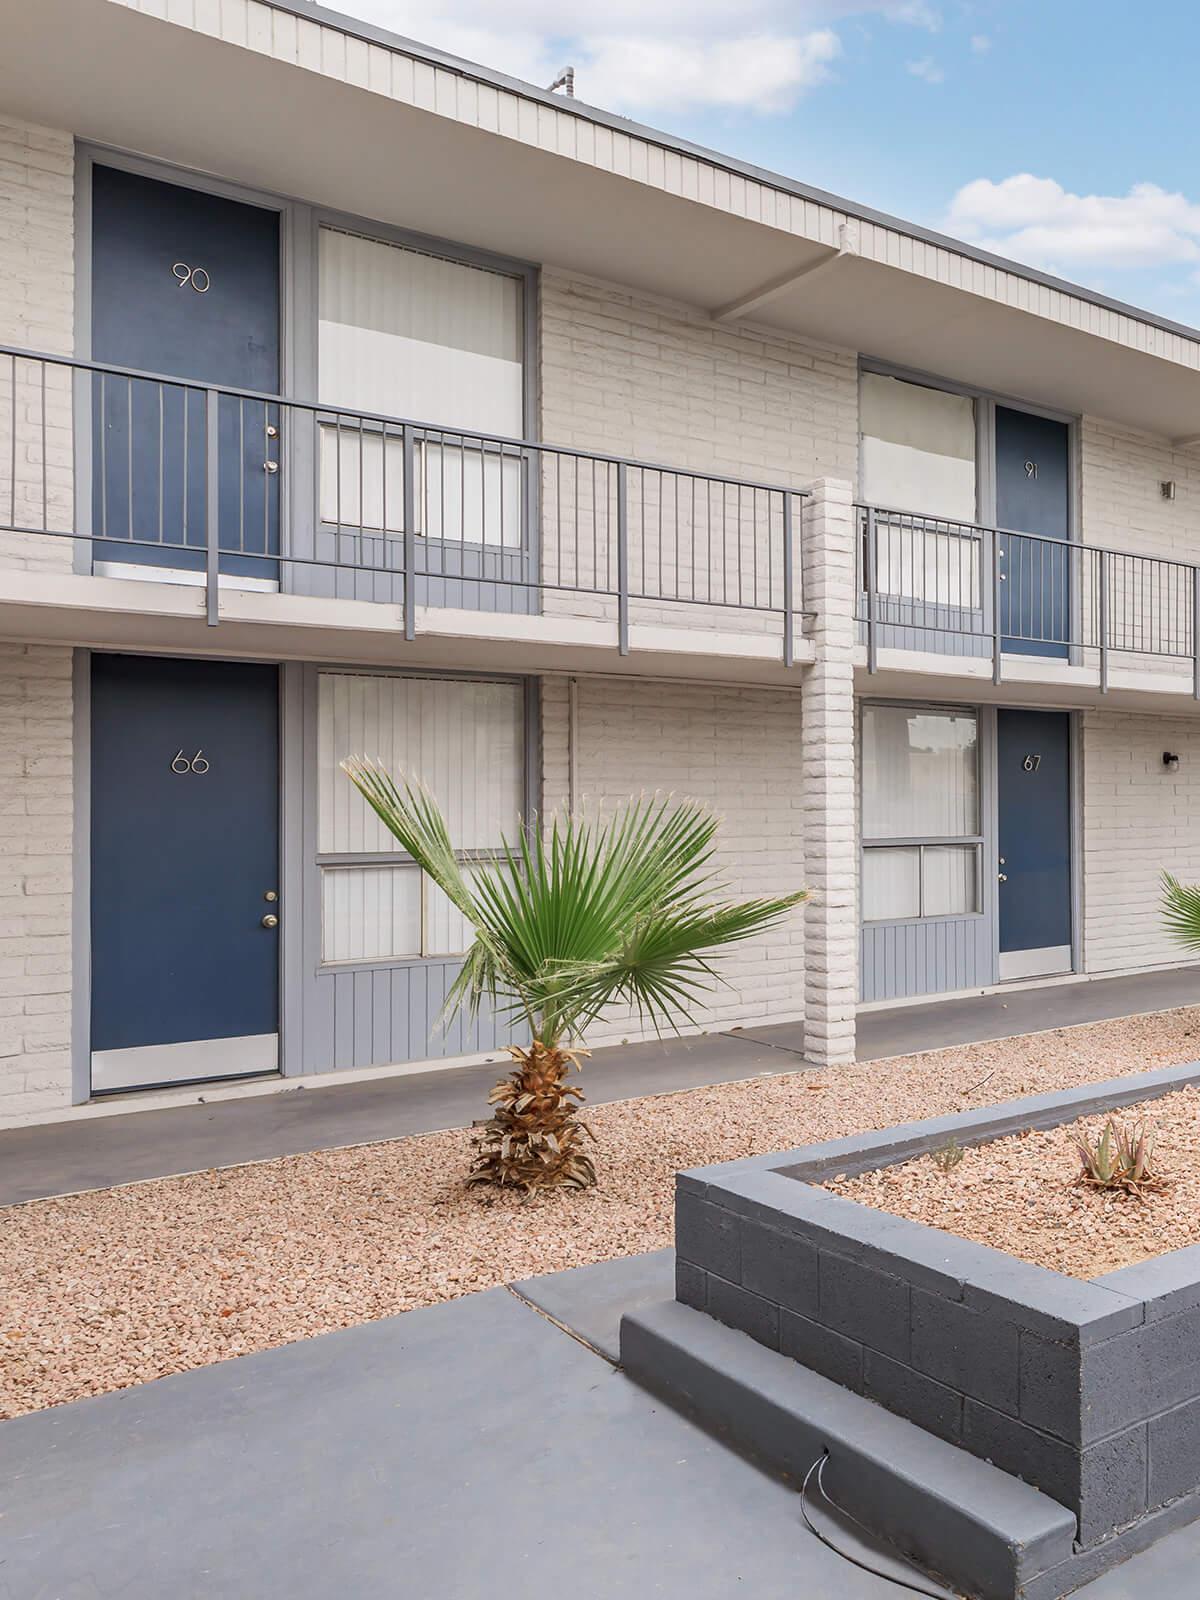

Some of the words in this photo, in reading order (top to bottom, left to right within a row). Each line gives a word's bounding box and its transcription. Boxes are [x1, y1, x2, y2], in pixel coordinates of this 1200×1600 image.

[172, 262, 210, 292] 90
[1025, 461, 1038, 479] 91
[171, 749, 210, 774] 66
[1024, 754, 1041, 771] 67
